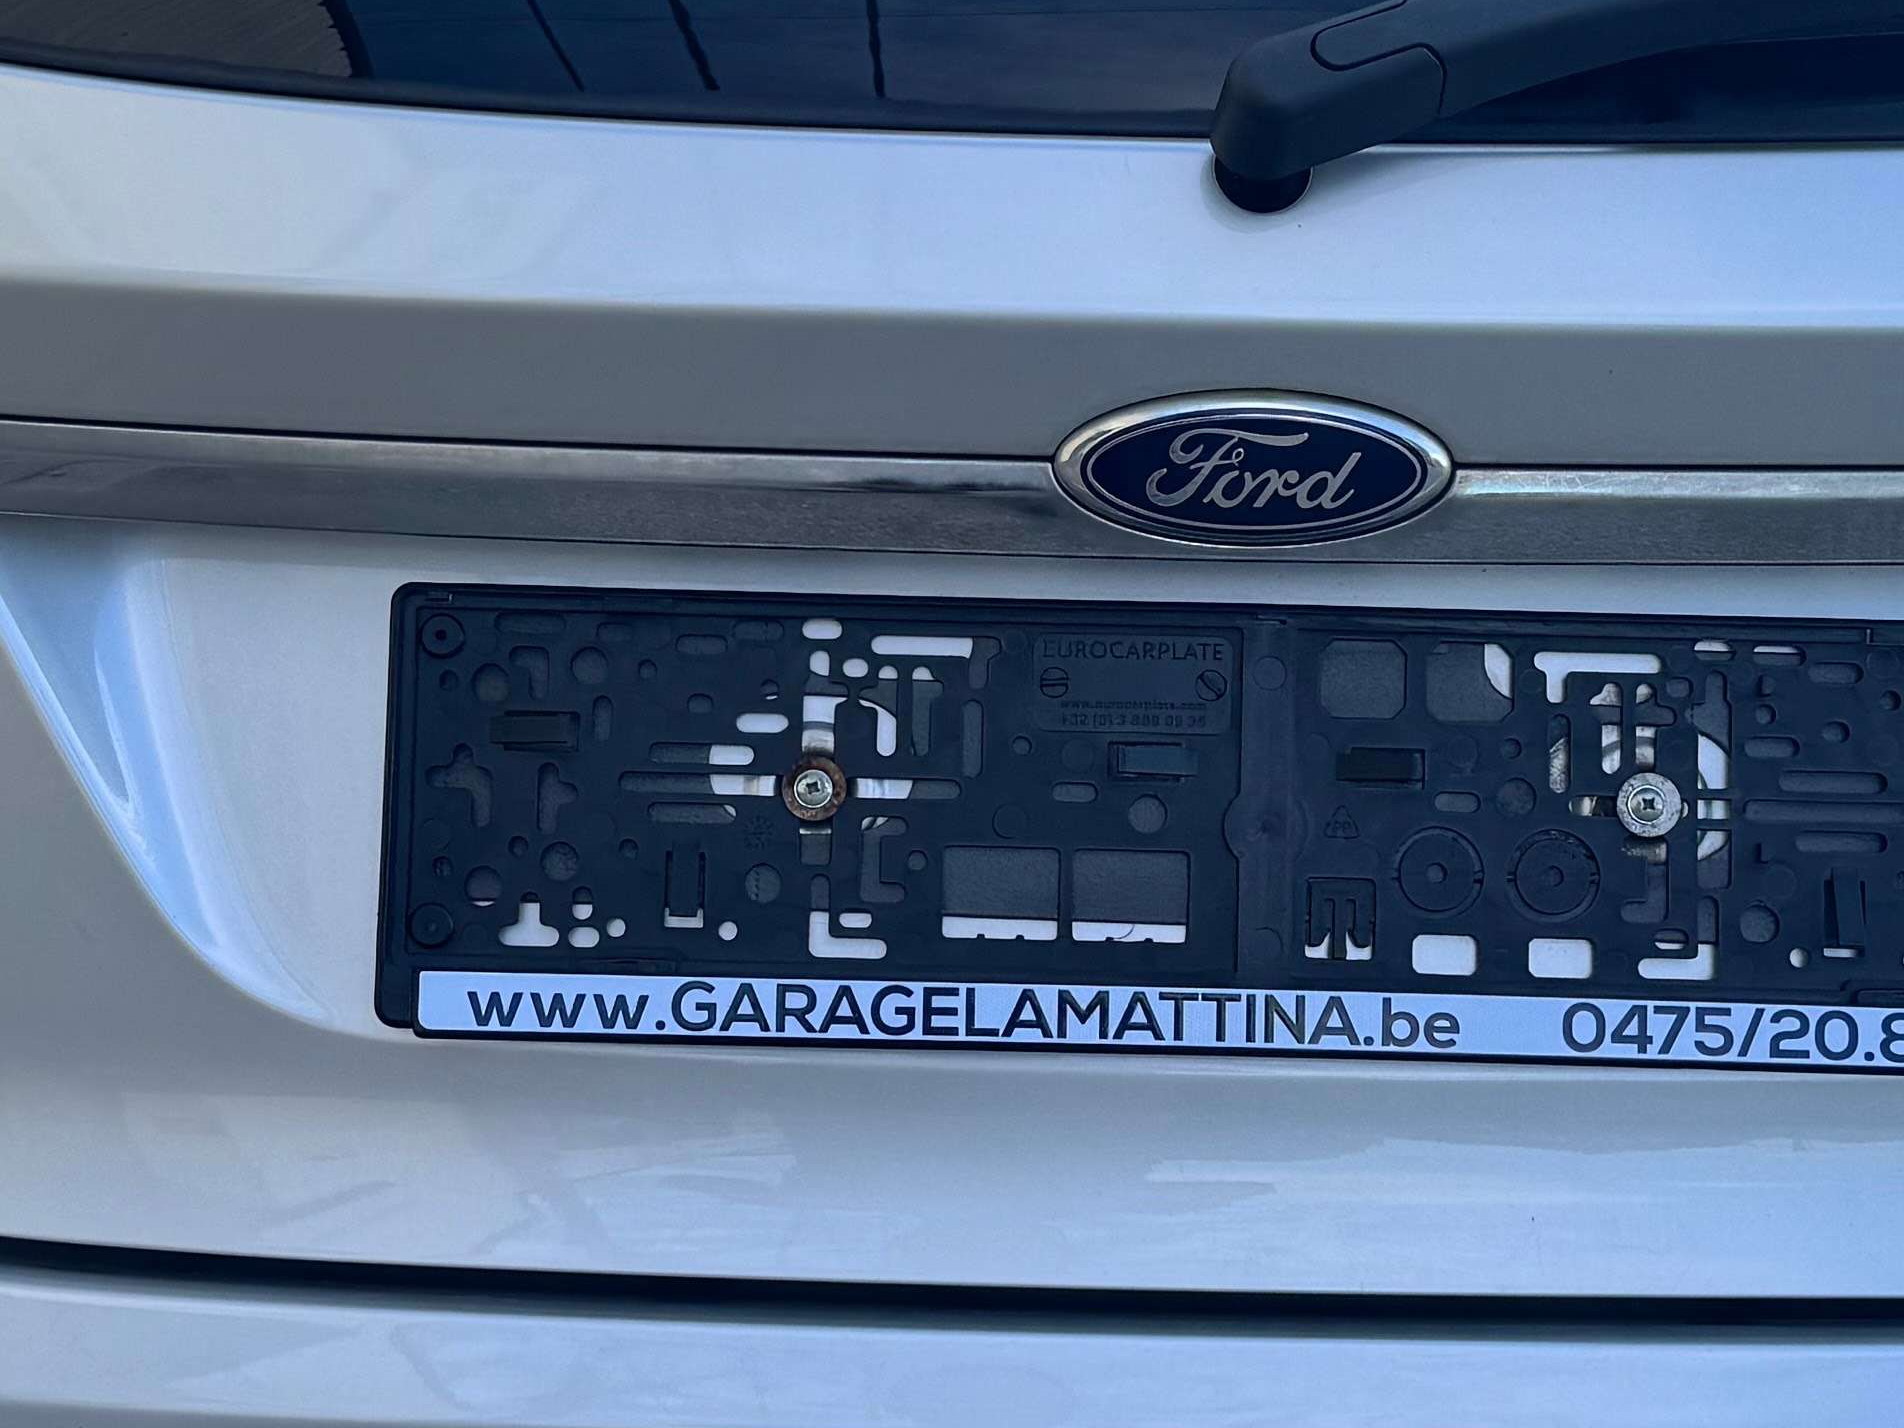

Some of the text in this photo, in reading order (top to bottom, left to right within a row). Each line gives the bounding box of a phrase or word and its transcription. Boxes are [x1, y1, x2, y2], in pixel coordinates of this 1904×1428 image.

[1145, 427, 1362, 509] Ford
[1043, 639, 1224, 661] EUROCARPLATE
[468, 981, 1460, 1049] www.GARAGELAMATTINA.be
